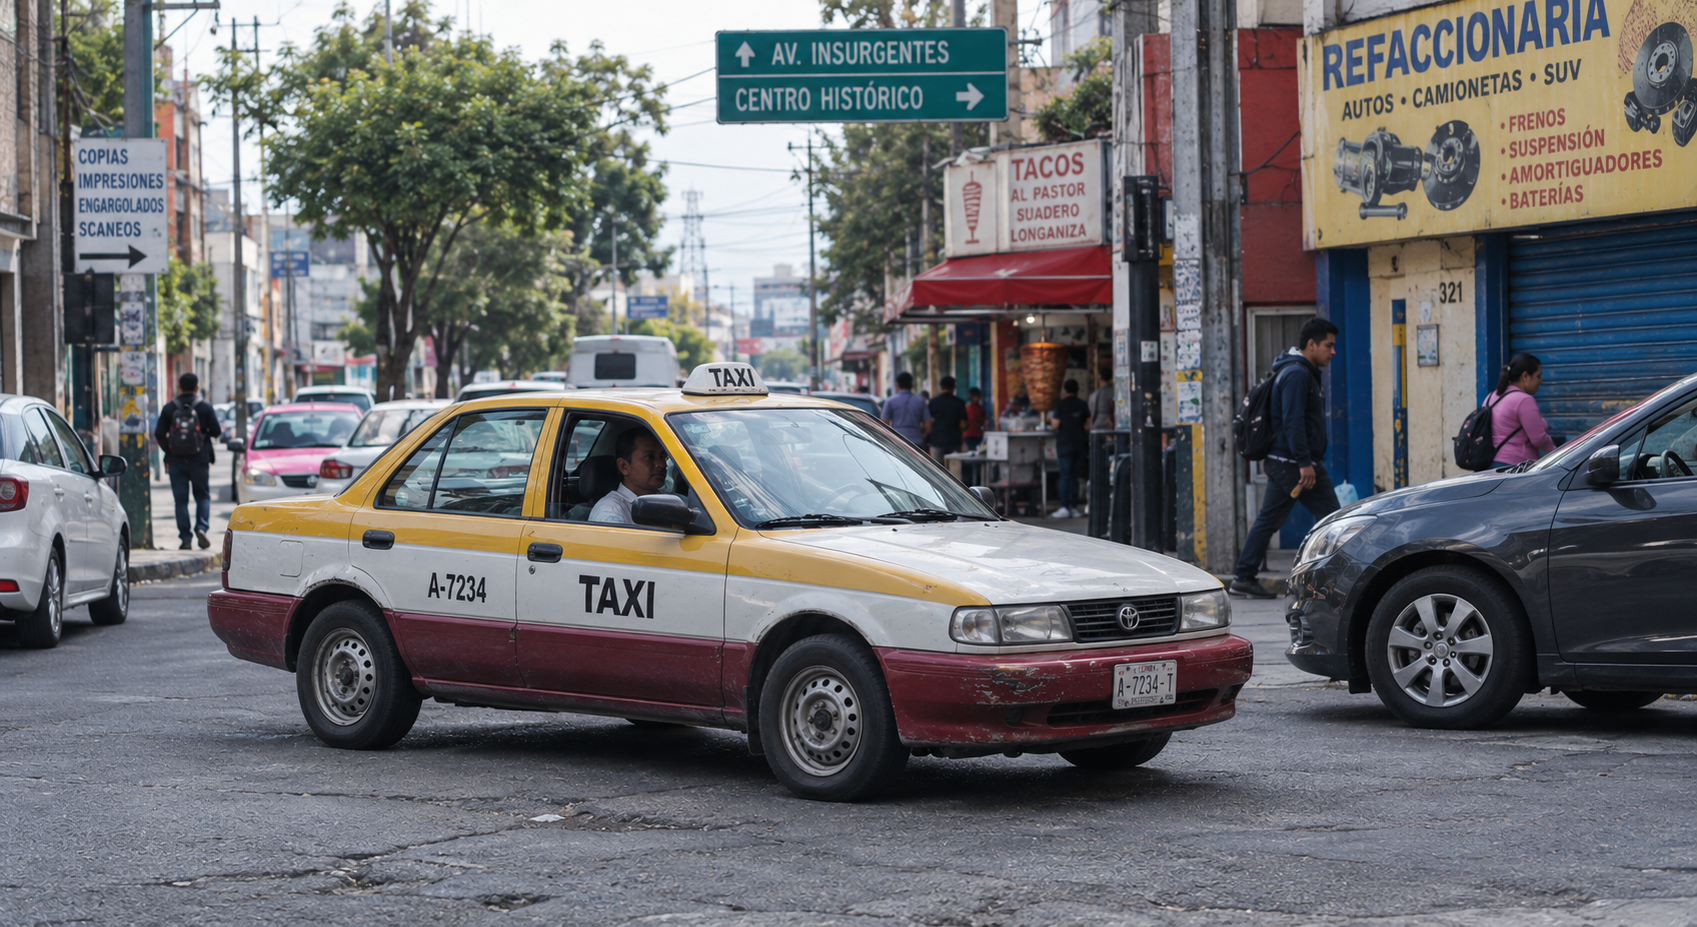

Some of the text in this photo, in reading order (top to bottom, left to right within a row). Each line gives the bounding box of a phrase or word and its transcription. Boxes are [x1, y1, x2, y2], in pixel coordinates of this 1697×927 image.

[771, 40, 950, 65] AV. INSURGENTES
[735, 80, 924, 112] CENTRO HISTÓRICO
[1341, 58, 1582, 121] AUTOS CAMIONETAS SUV
[1509, 107, 1566, 133] FRENOS
[1509, 124, 1605, 159] SUSPENSIÓN
[78, 148, 128, 165] COPIAS
[1011, 152, 1084, 181] TACOS
[1509, 148, 1663, 185] AMORTIGUADORES
[78, 173, 164, 189] IMPRESIONES
[1011, 182, 1086, 202] AL PASTOR
[78, 197, 164, 214] ENGARGOLADOS
[1509, 181, 1584, 210] BATERÍAS
[1016, 203, 1080, 222] SUADERO
[79, 221, 141, 237] SCANEOS
[1010, 223, 1087, 243] LONGANIZA
[1439, 280, 1462, 304] 321
[708, 368, 756, 387] TAXI
[427, 572, 487, 603] A-7234
[578, 574, 656, 619] TAXI
[1117, 673, 1174, 697] A-7234-T
